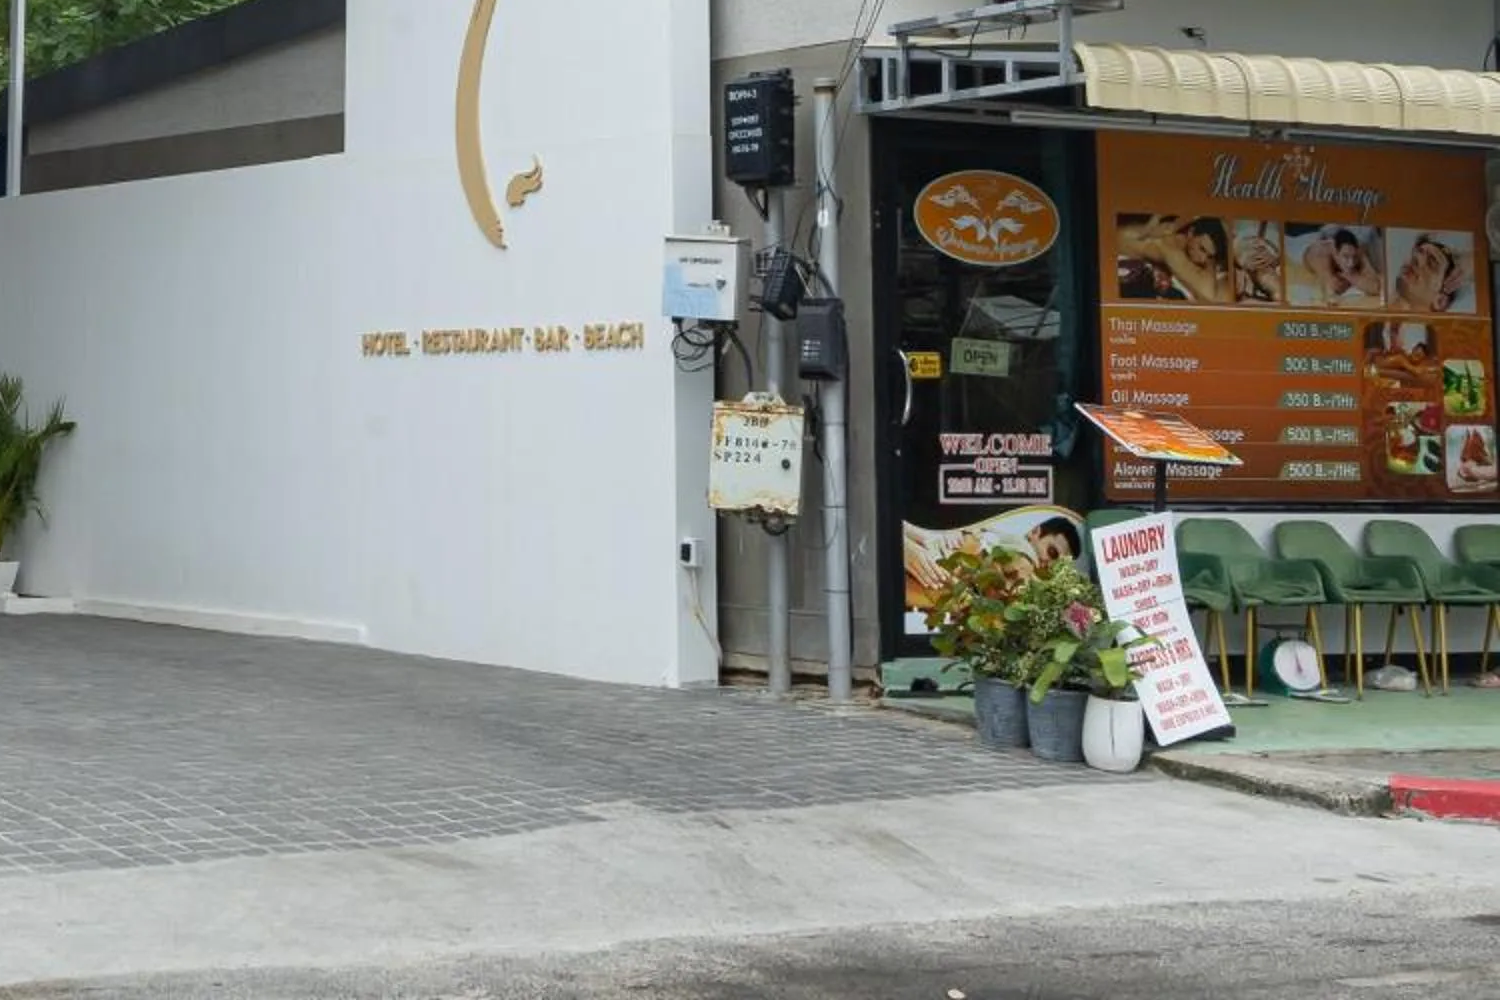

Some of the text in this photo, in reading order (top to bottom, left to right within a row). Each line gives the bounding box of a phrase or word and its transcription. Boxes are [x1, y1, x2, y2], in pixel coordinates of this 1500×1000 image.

[1213, 153, 1385, 224] Health Massage
[1108, 317, 1197, 336] Thai Massage
[361, 322, 645, 357] HOTEL RESTAURANT BAR BEACH
[1111, 353, 1199, 372] Foot Massage
[1111, 390, 1189, 407] Oil Massage
[940, 433, 1053, 456] WELCOME
[974, 457, 1019, 474] OPEN
[1165, 462, 1223, 479] Massage
[1102, 524, 1165, 564] LAUNDRY
